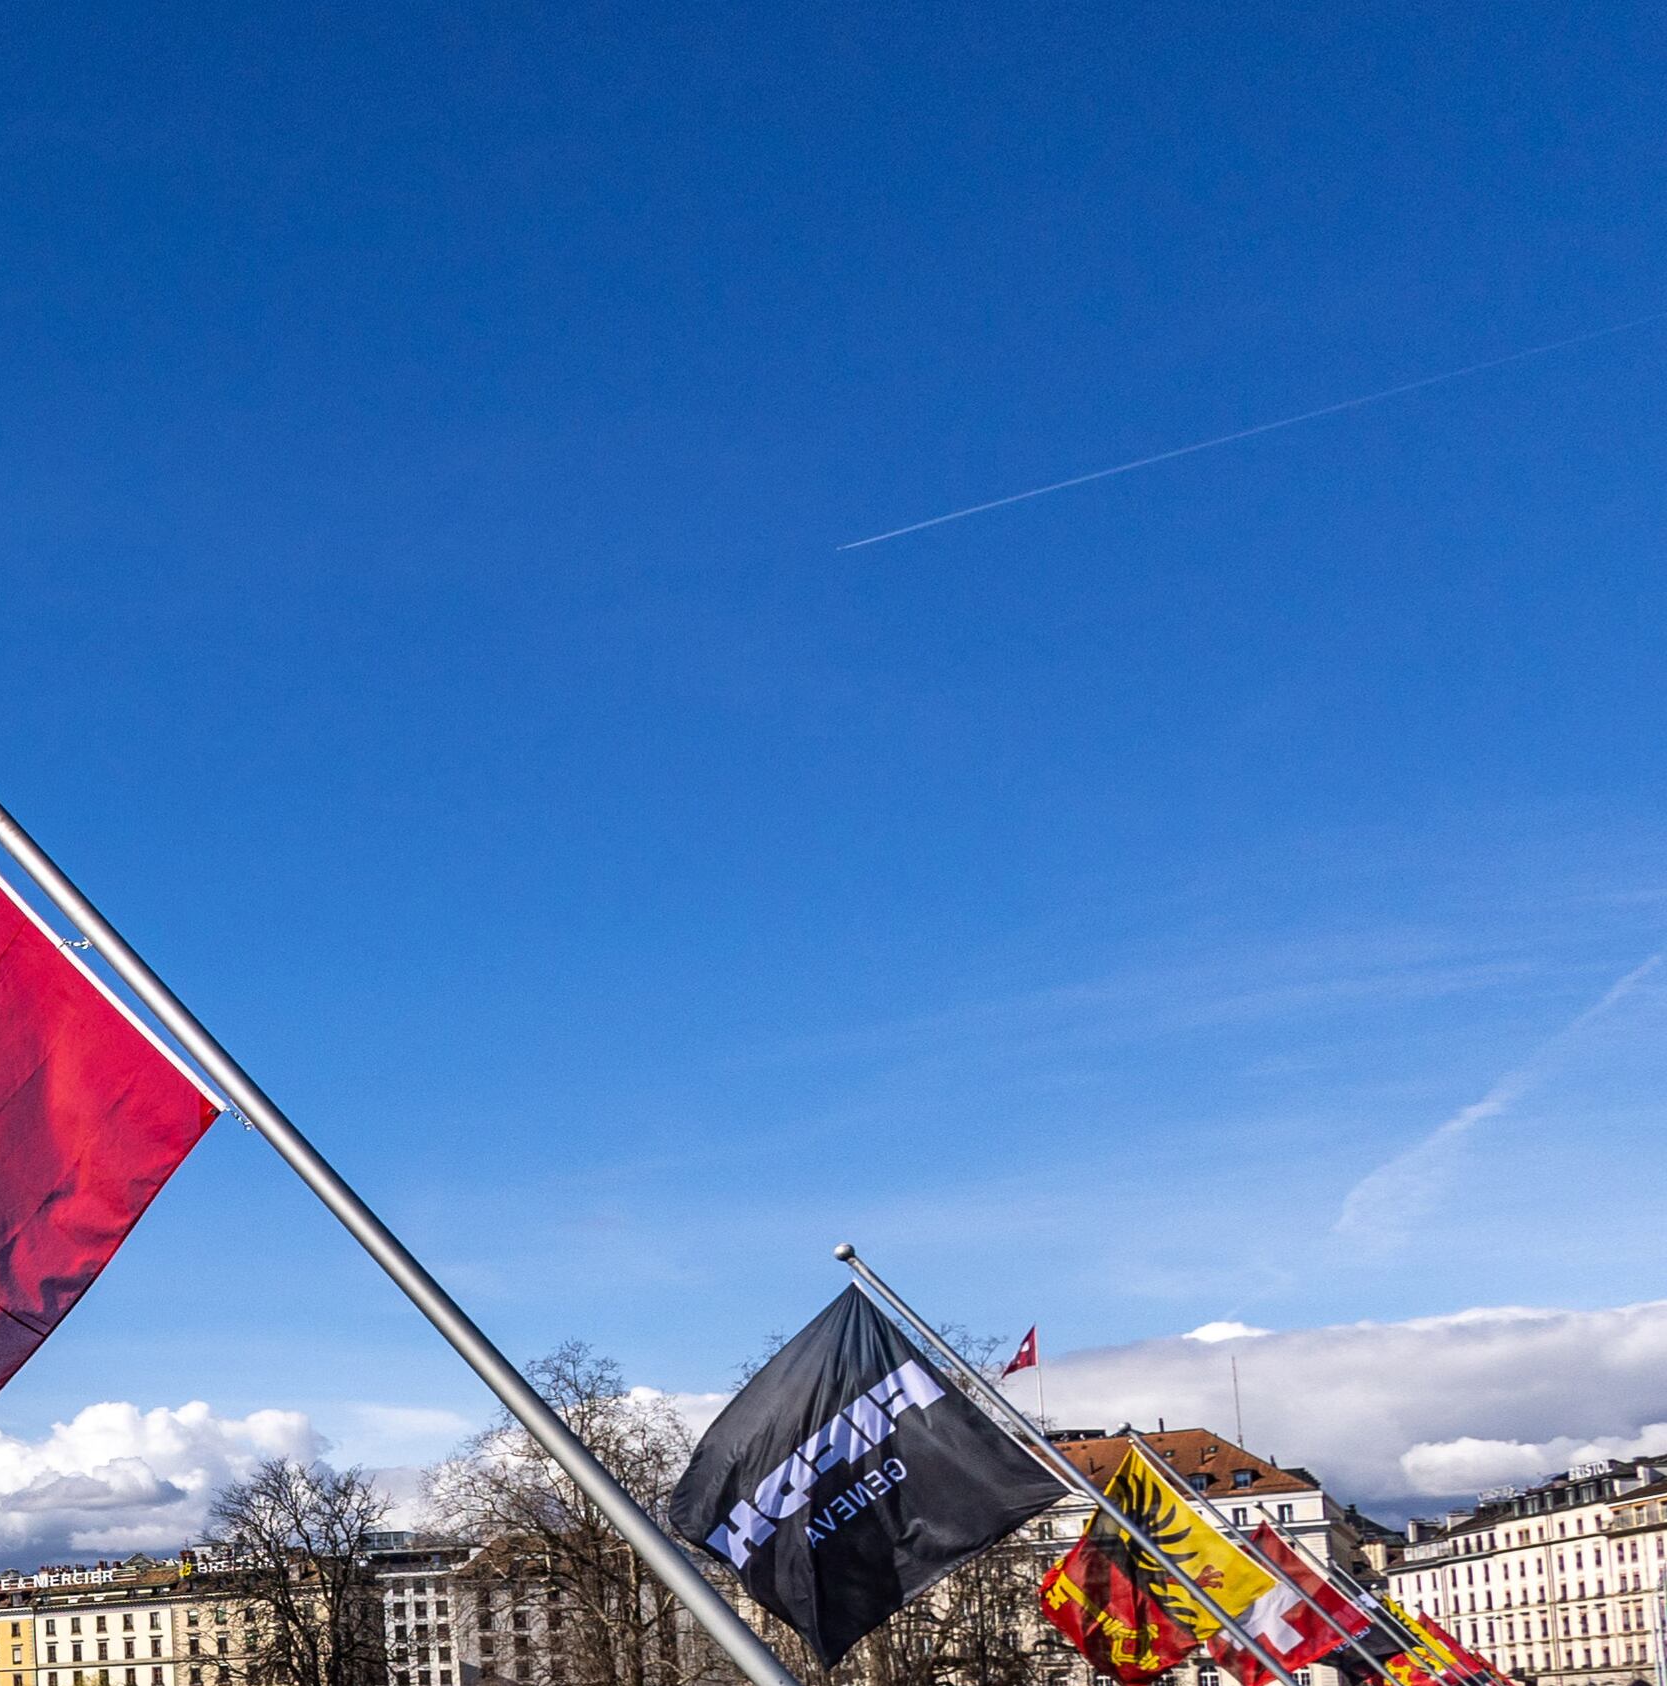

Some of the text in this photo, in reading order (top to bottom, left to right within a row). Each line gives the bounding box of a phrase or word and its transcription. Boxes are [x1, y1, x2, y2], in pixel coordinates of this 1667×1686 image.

[1568, 1459, 1614, 1481] BRISTOL
[16, 1578, 27, 1589] &
[33, 1569, 114, 1588] MERCIER
